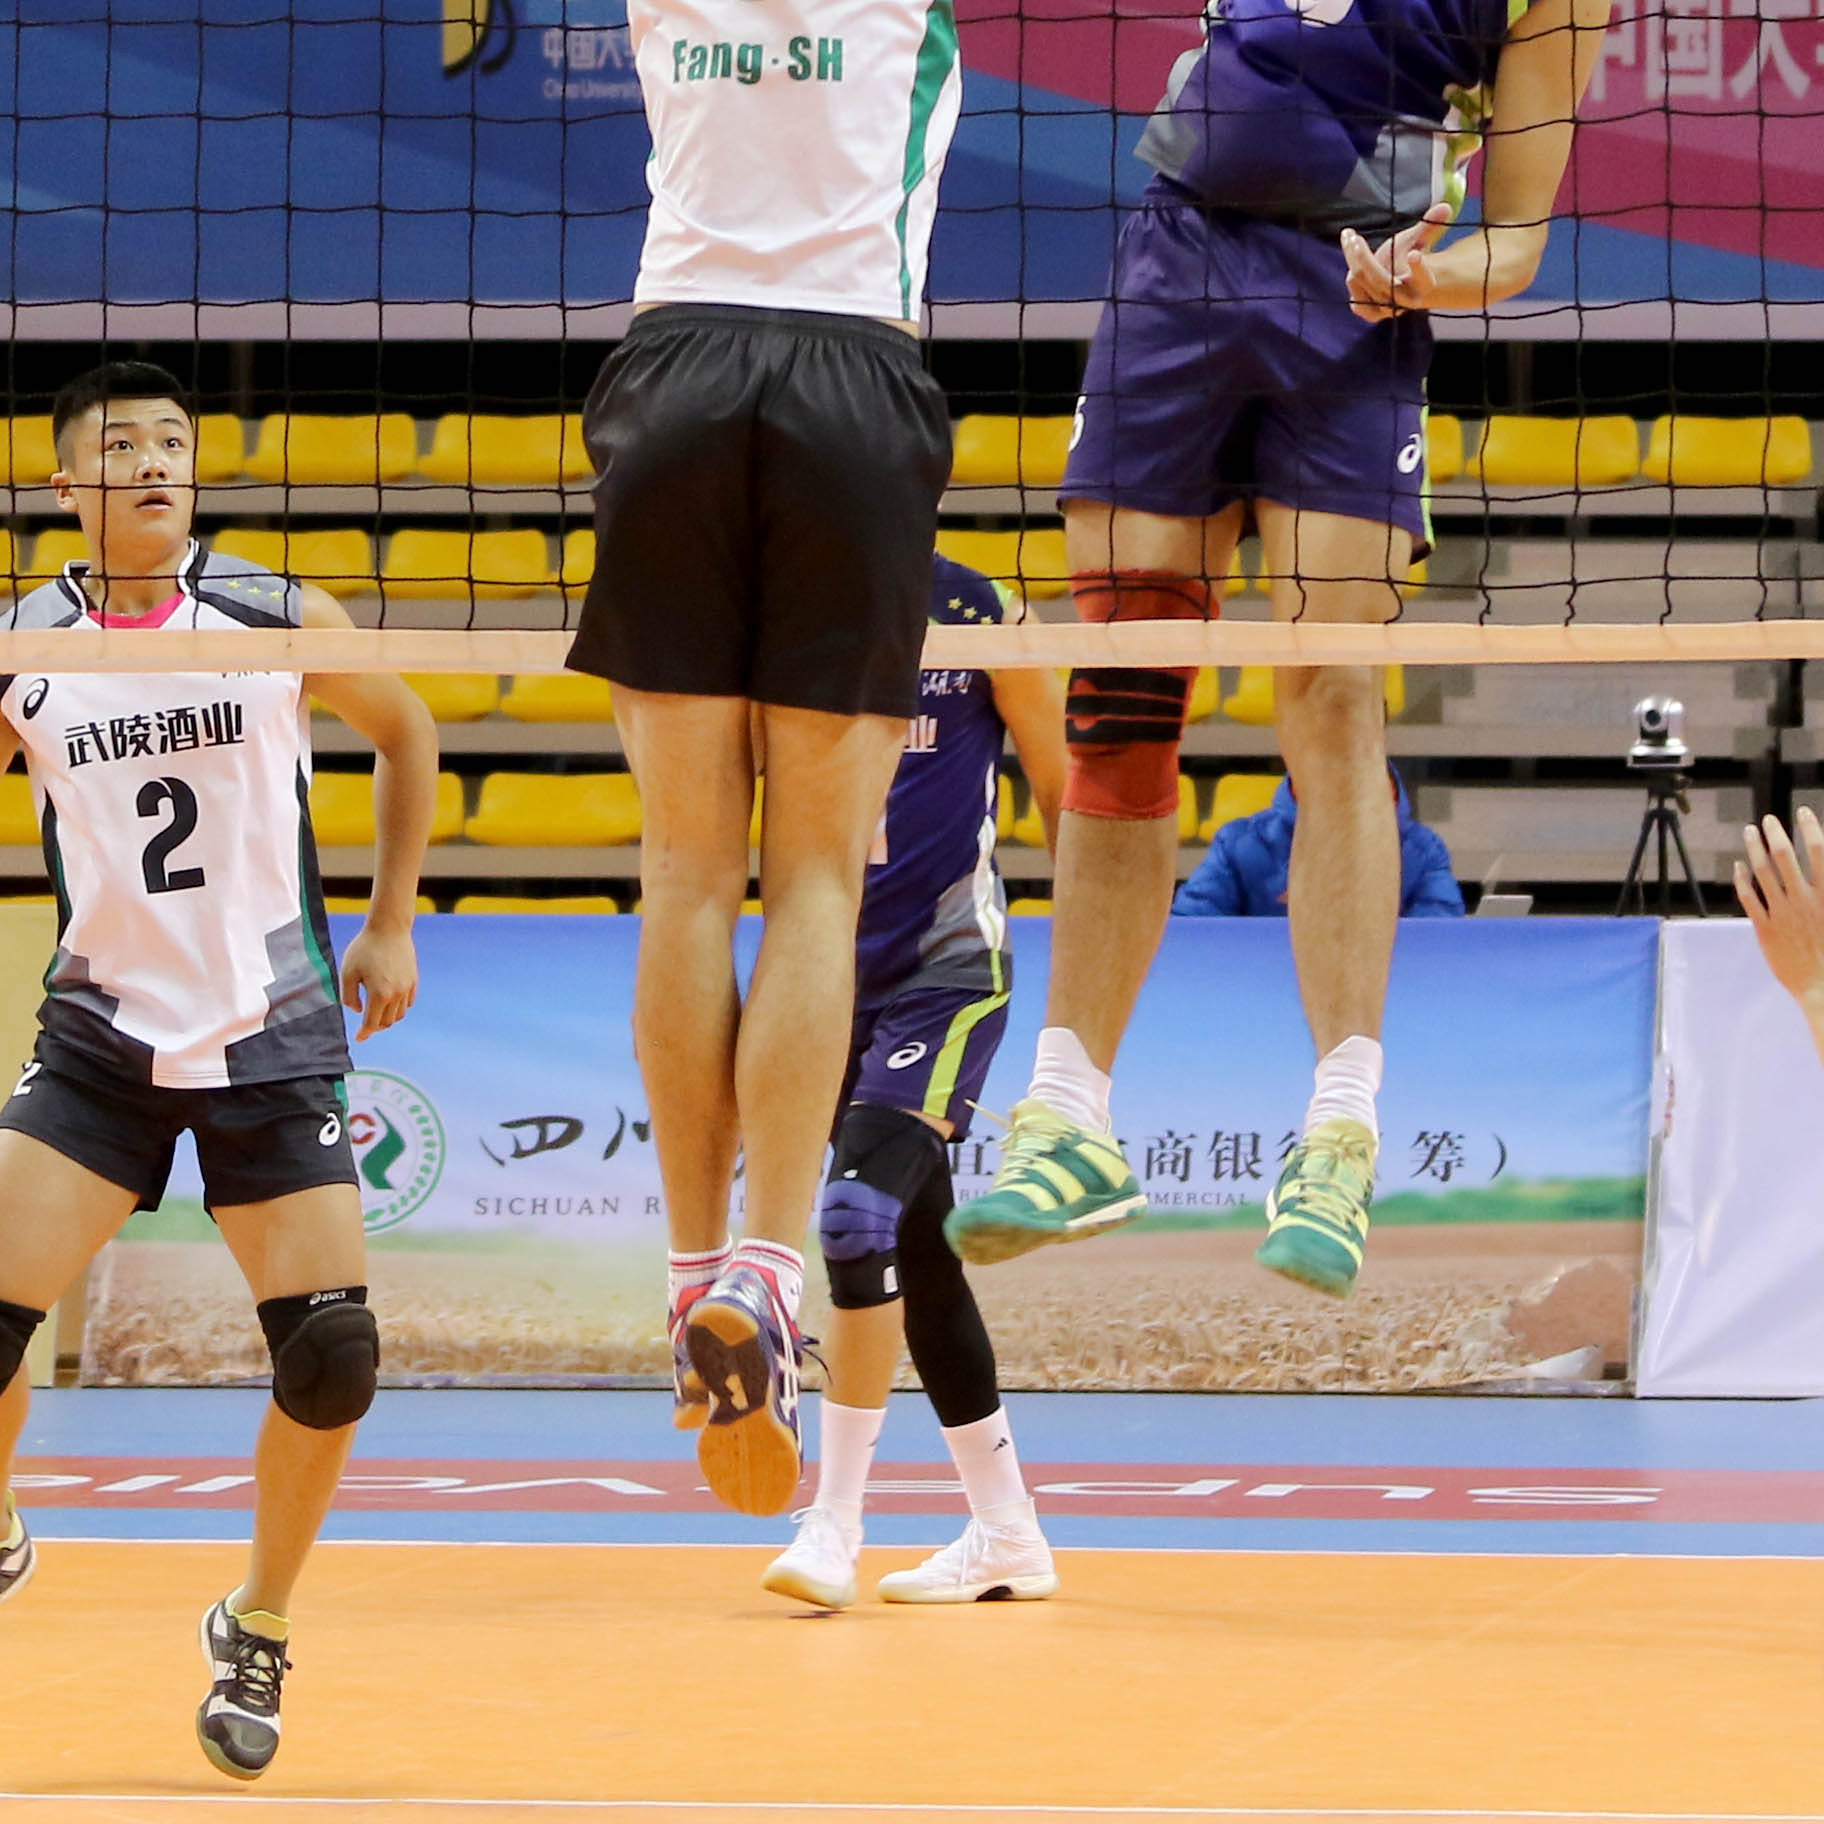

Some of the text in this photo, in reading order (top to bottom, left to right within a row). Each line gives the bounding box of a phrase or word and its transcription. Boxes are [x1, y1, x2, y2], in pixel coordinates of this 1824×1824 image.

[65, 700, 245, 768] 武陵酒业
[136, 776, 205, 895] 2
[474, 1197, 620, 1216] SICHUAN
